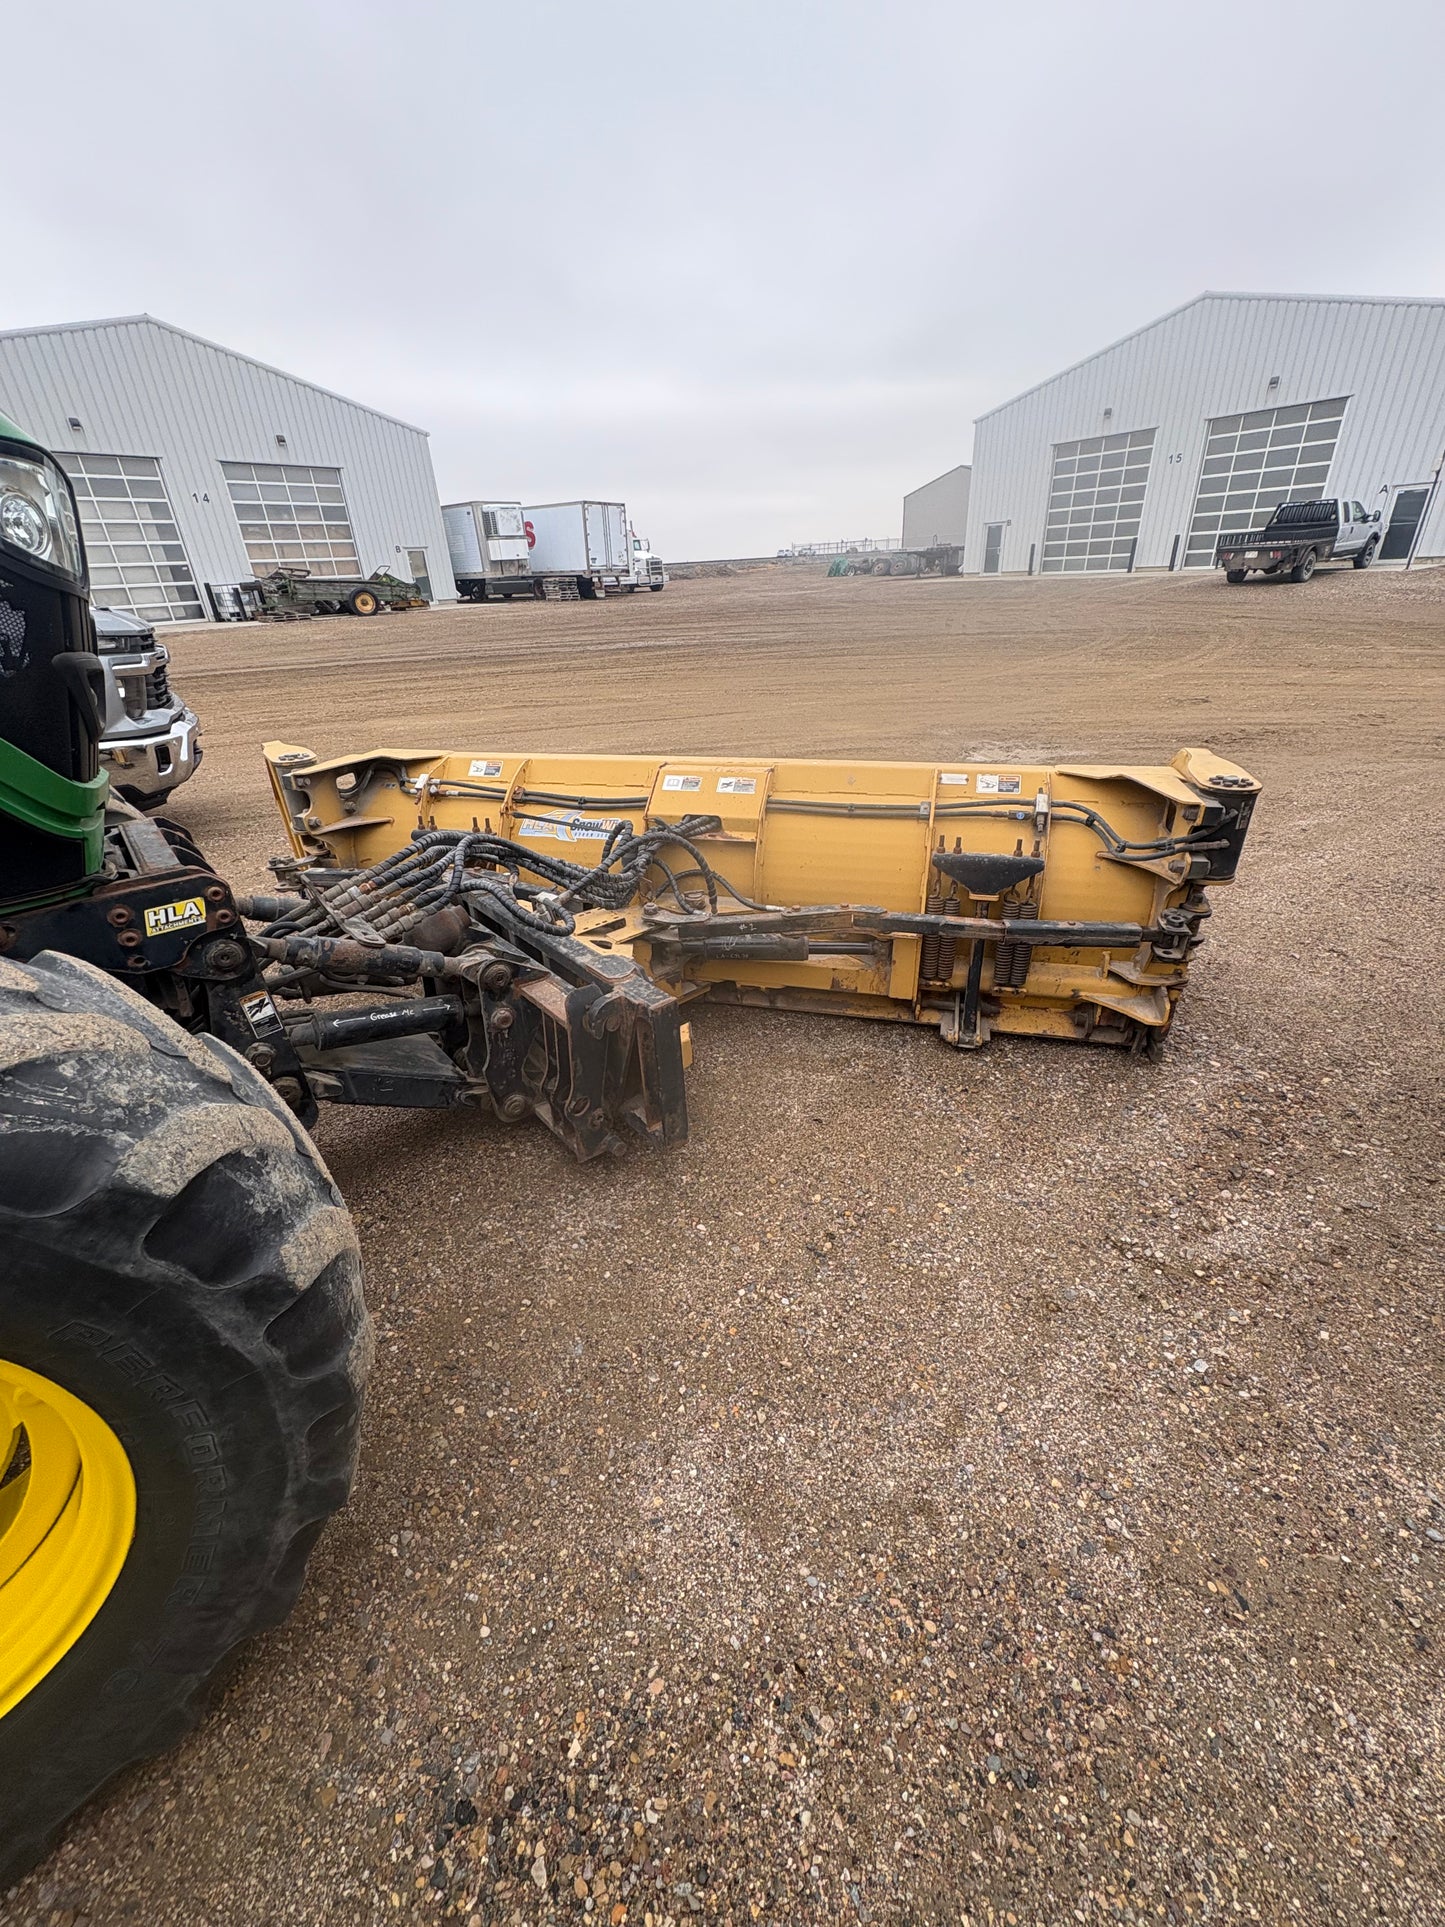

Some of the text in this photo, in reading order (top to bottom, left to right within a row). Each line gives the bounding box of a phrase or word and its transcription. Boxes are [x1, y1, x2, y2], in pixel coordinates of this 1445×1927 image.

[1168, 453, 1182, 464] 15
[1378, 484, 1388, 494] A
[192, 492, 210, 503] 14
[148, 901, 201, 927] HLA
[369, 1012, 398, 1021] Grease
[48, 1319, 229, 1608] PERFORMER
